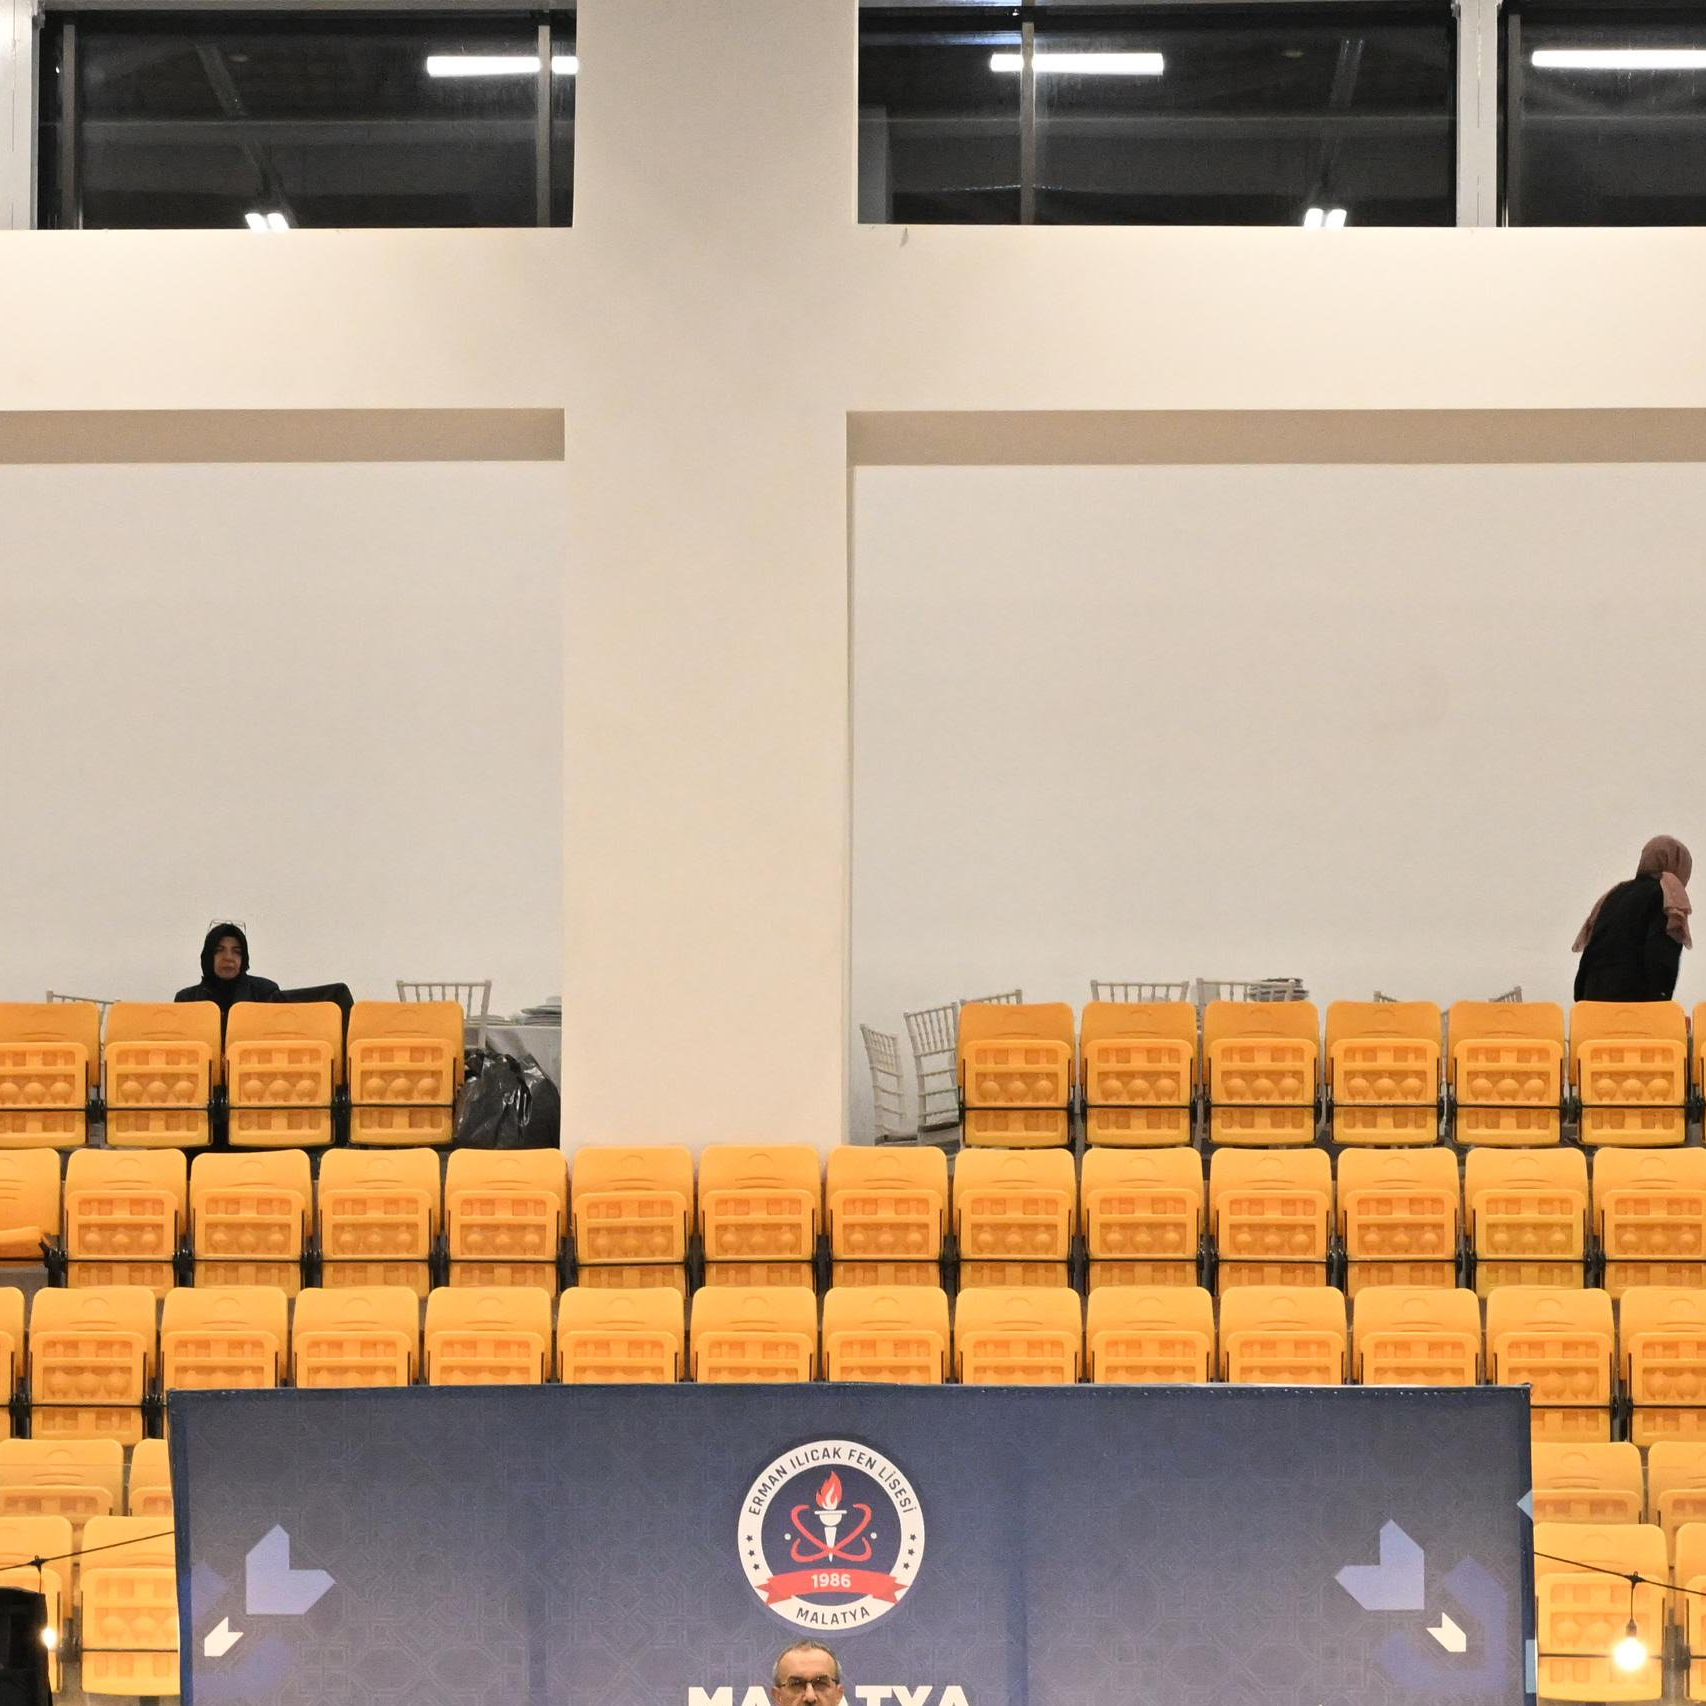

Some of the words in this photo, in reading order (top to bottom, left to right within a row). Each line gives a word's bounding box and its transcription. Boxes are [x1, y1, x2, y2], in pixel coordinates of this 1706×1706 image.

[748, 1465, 788, 1516] ERMAN
[790, 1446, 842, 1469] ILICAK
[847, 1449, 877, 1470] FEN
[878, 1466, 917, 1514] LİSESİ
[811, 1573, 852, 1588] 1986
[796, 1605, 870, 1625] MALATYA
